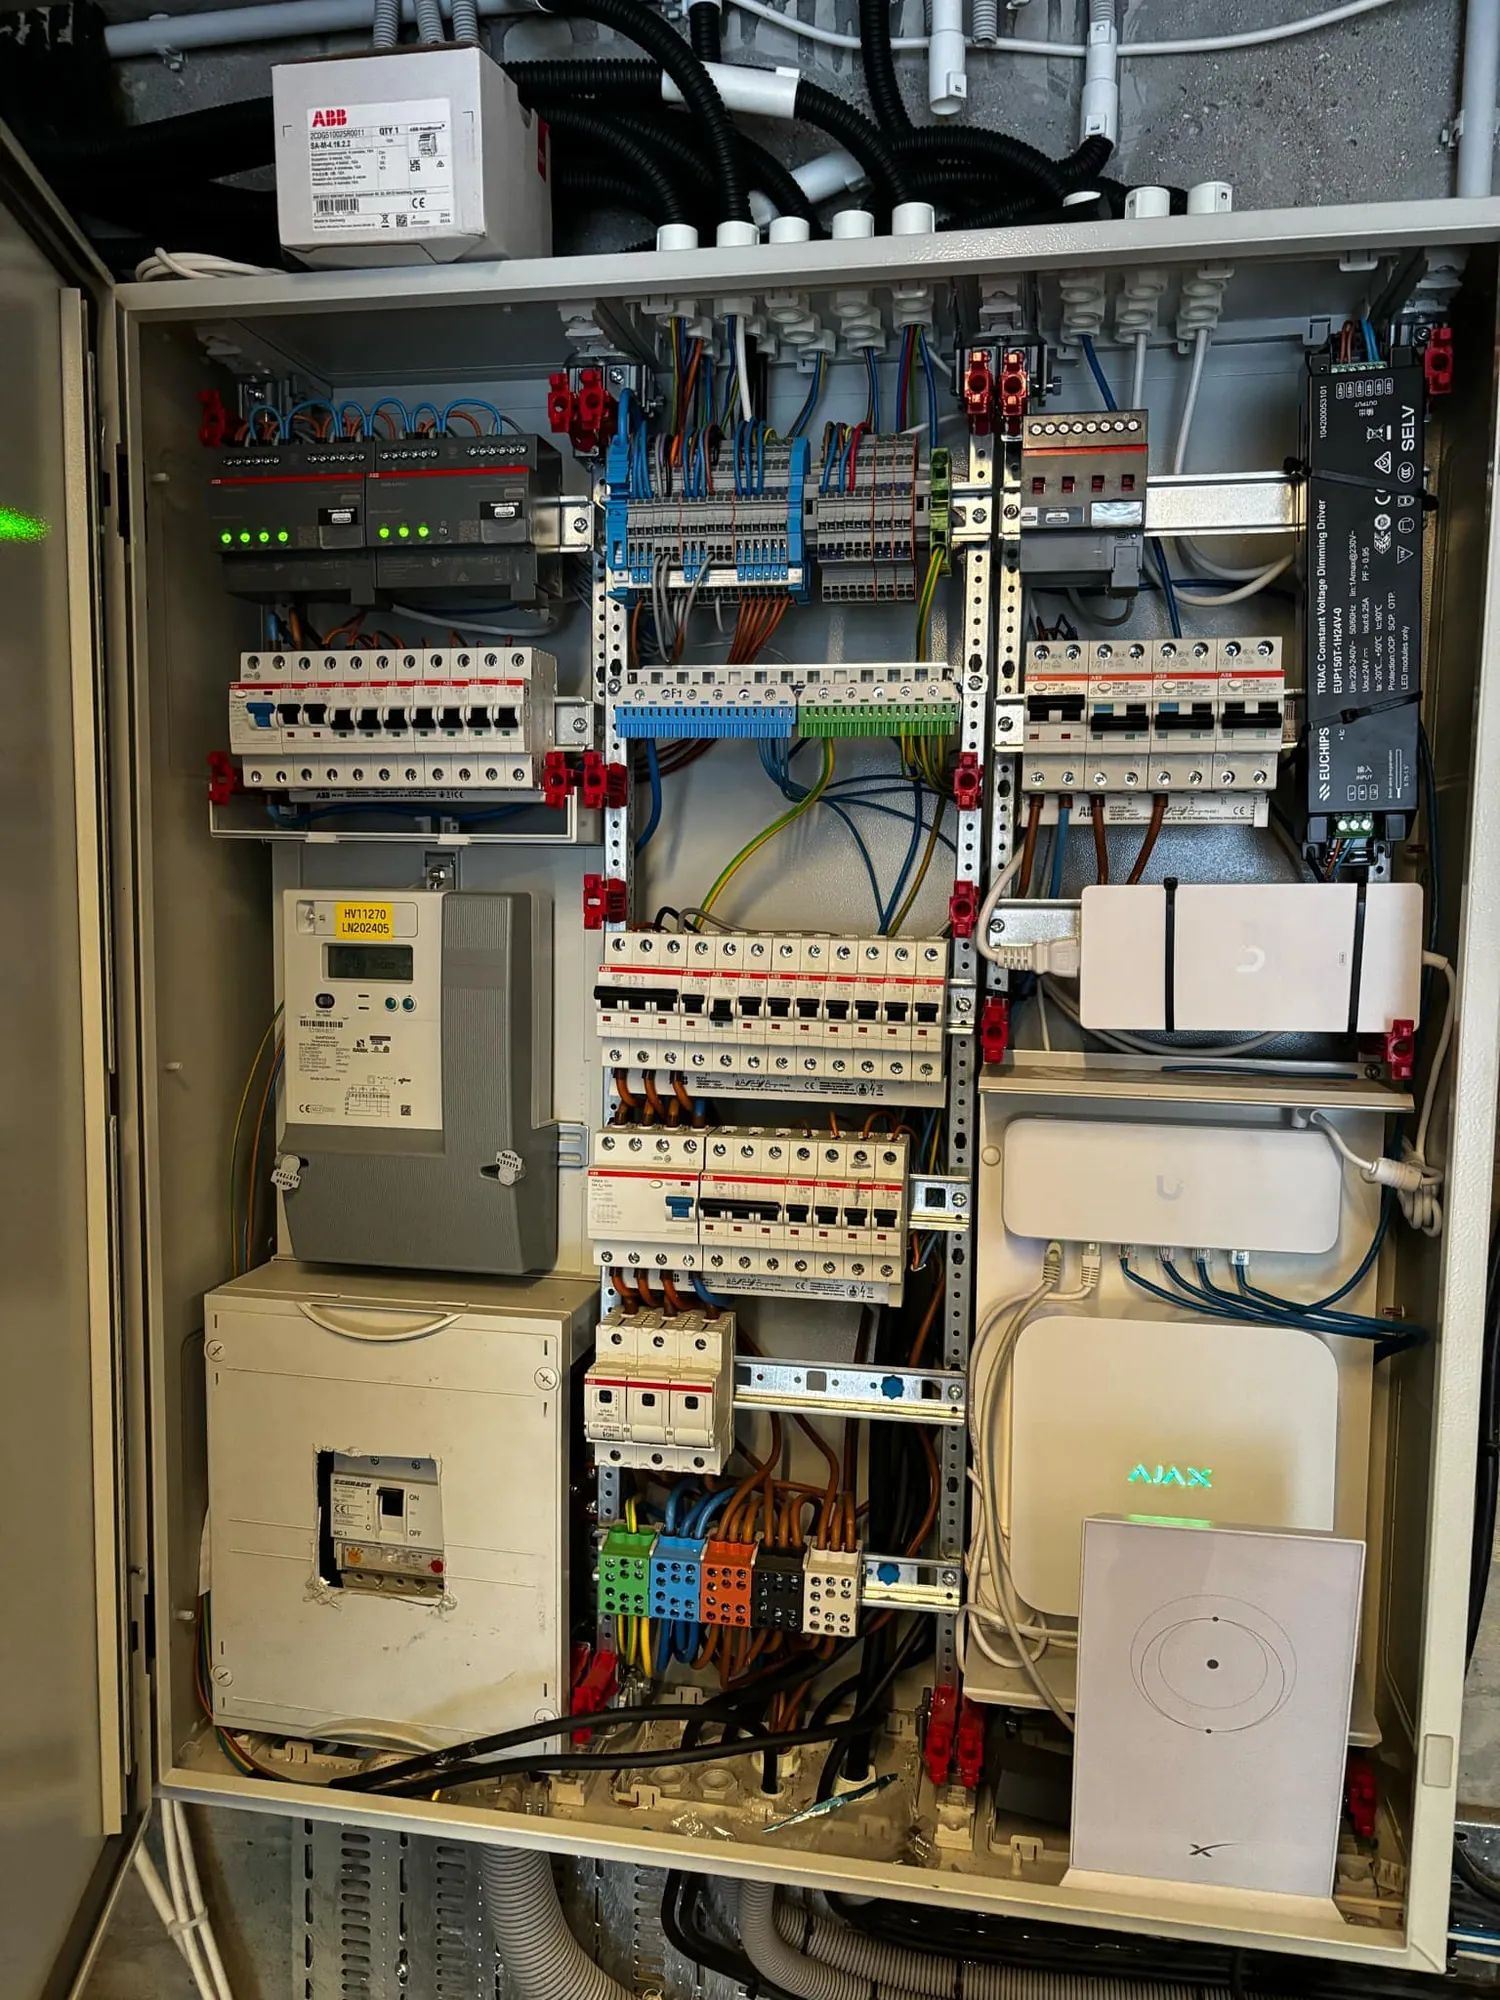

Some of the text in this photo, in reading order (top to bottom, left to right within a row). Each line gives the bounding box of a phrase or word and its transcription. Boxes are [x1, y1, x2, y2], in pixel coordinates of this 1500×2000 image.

[312, 109, 347, 127] ABB
[379, 127, 393, 136] QTY
[1354, 400, 1378, 408] OUTPUT
[1401, 405, 1415, 451] SELV
[1362, 571, 1369, 581] PF
[1317, 500, 1327, 695] TRIAC Constant Voltage Dimming Driver
[1349, 604, 1357, 635] 50/60Hz
[1333, 607, 1342, 694] EUP150T-1H24V-0
[1401, 626, 1410, 690] LED modules only
[671, 688, 682, 699] F1
[1319, 727, 1330, 780] EUCHIPS
[344, 909, 386, 919] HV11270
[342, 923, 390, 934] LN202405
[1128, 1464, 1212, 1488] AJAX
[409, 1529, 422, 1537] OFF
